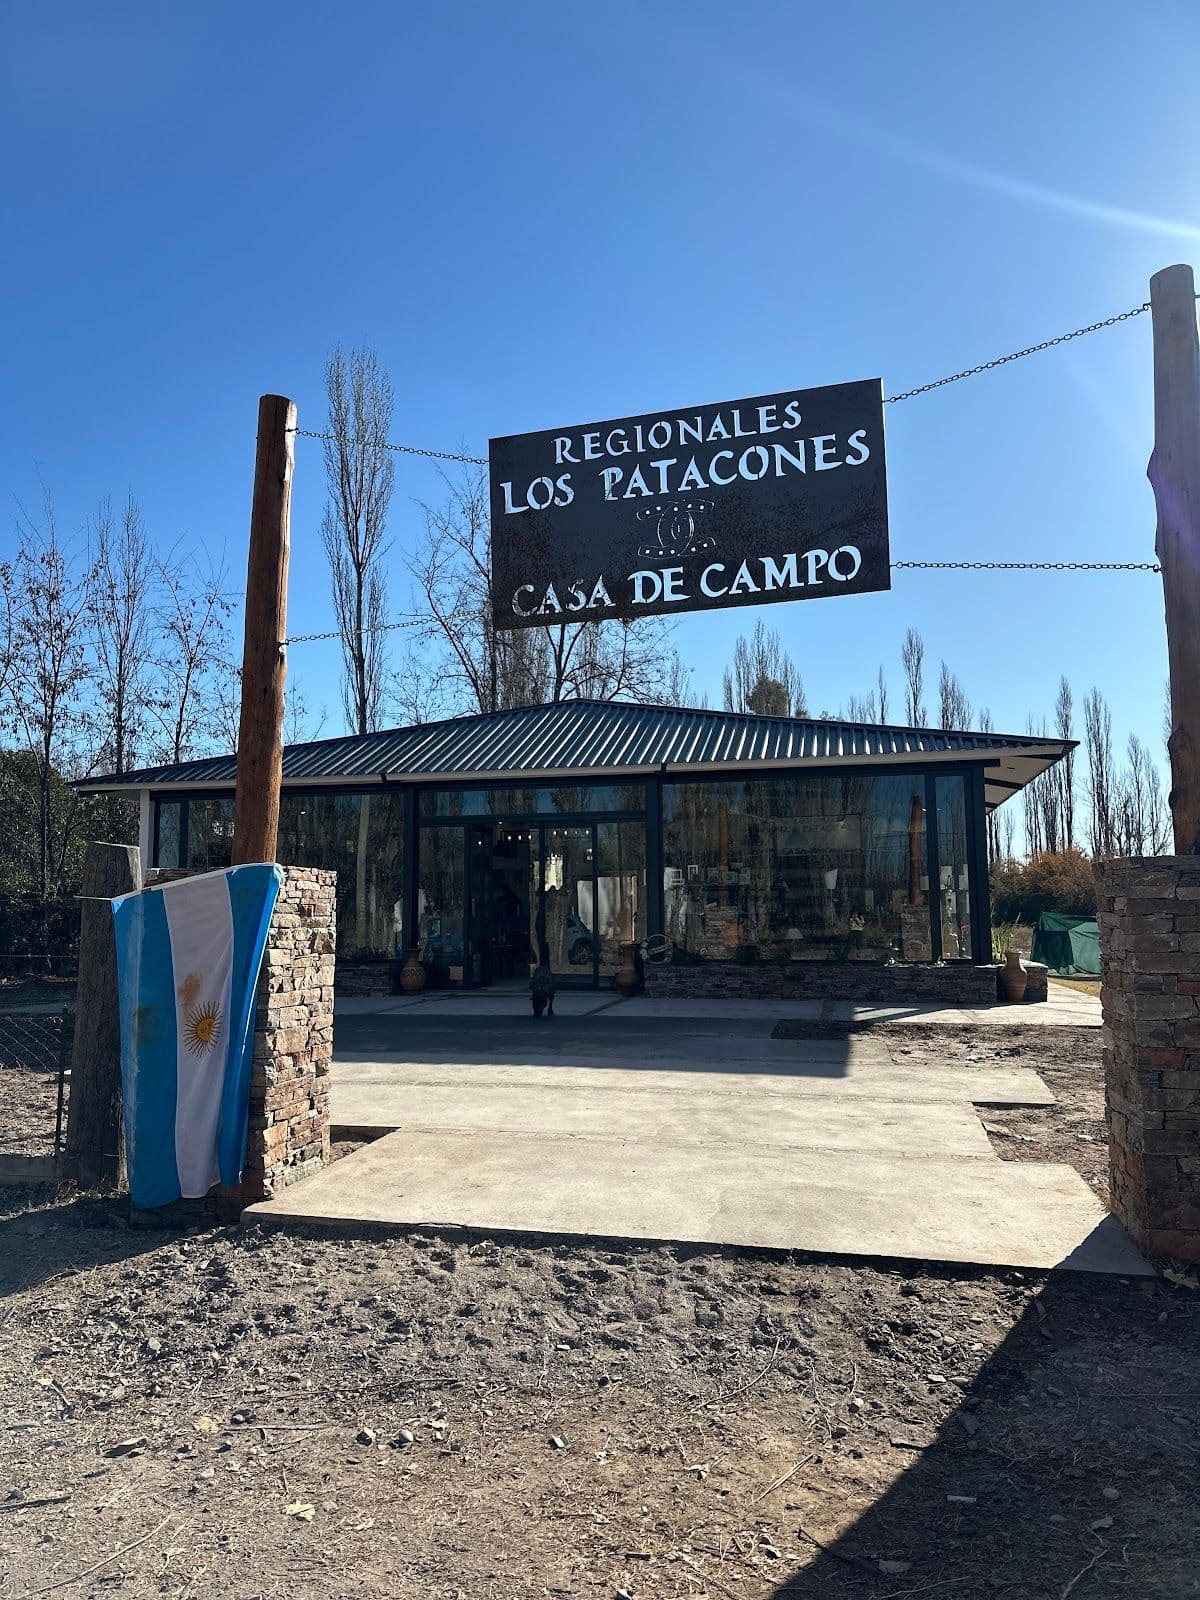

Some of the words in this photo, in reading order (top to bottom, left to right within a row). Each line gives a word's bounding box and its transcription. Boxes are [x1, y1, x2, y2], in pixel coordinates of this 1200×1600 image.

[552, 400, 802, 465] REGIONALES
[500, 472, 575, 515] LOS
[598, 429, 870, 501] PATACONES
[511, 574, 617, 617] CASA
[627, 566, 692, 604] DE
[700, 545, 862, 599] CAMPO
